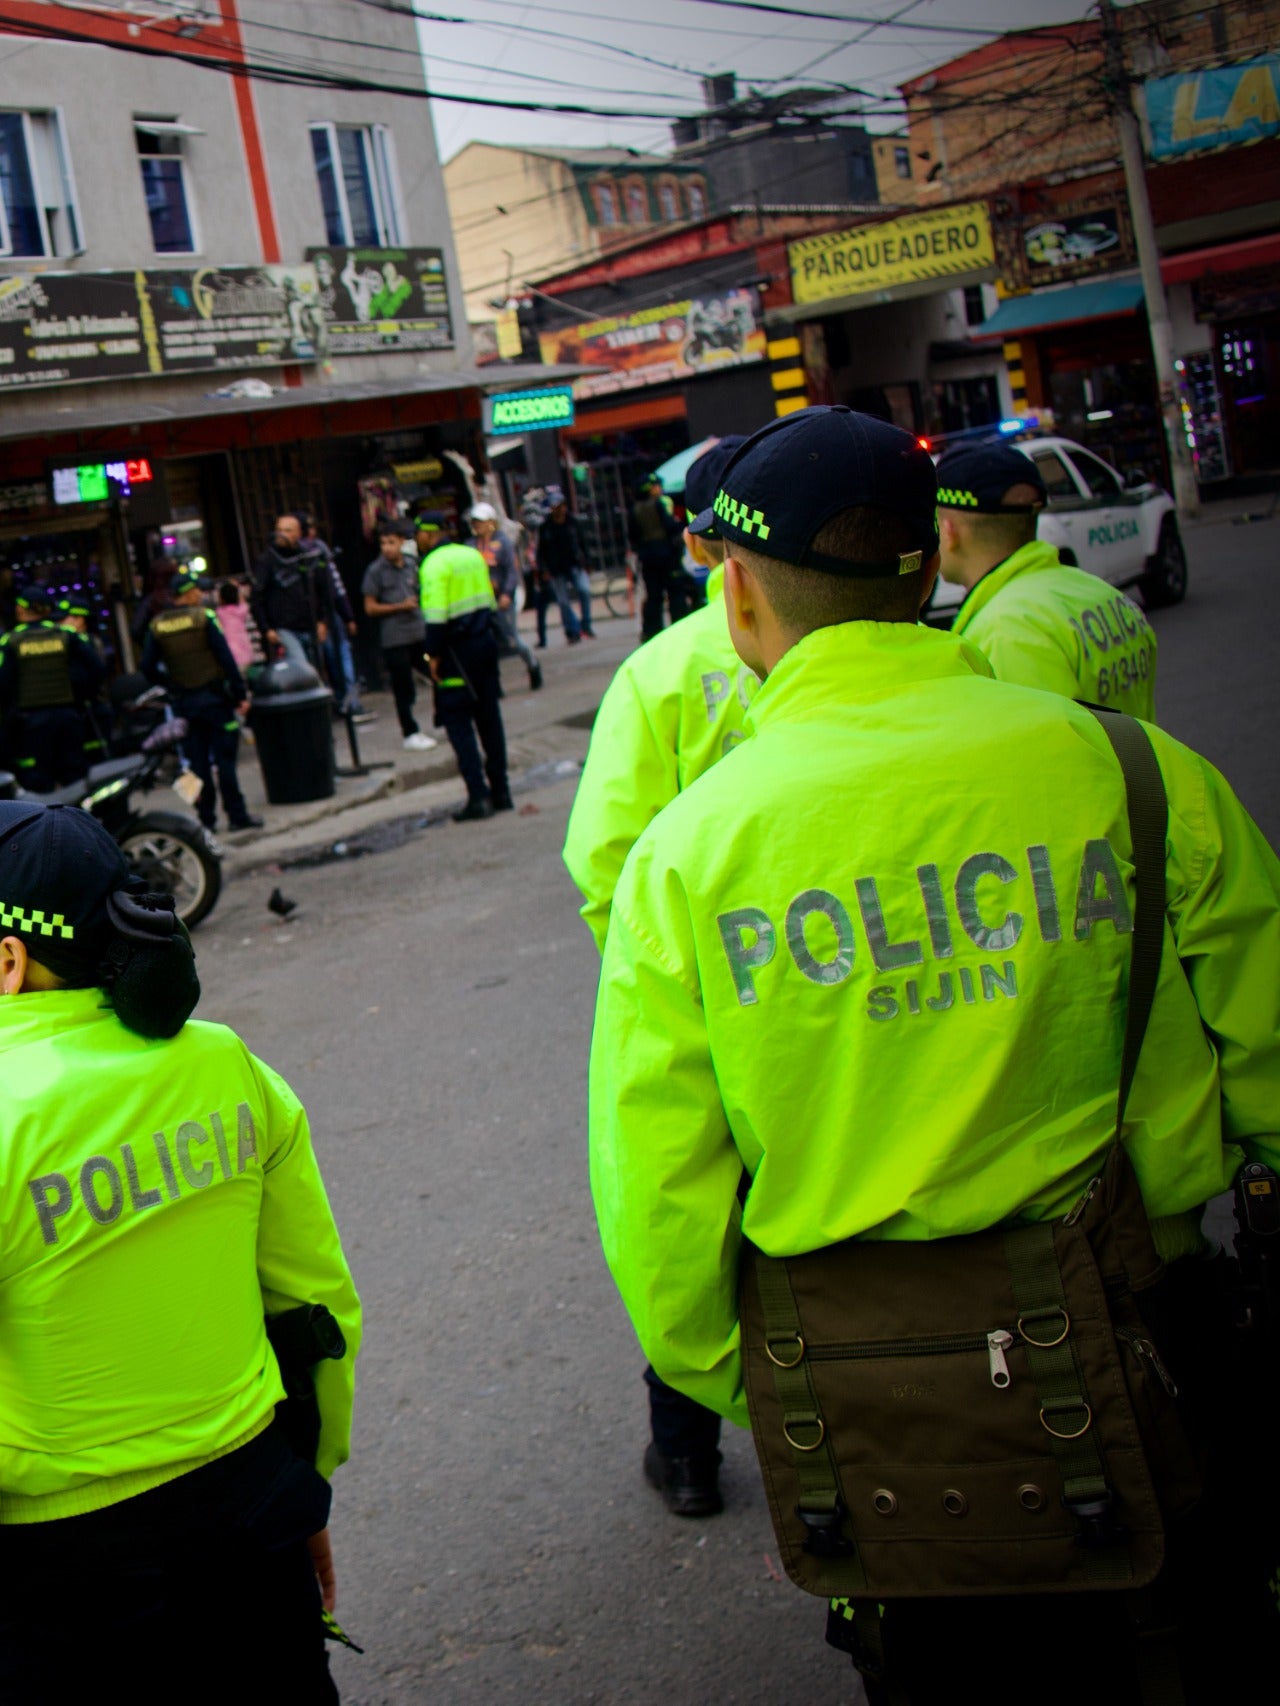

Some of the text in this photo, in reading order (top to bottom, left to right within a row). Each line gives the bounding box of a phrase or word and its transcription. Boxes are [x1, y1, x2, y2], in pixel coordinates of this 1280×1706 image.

[802, 223, 981, 281] PARQUEADERO
[1088, 519, 1140, 547] POLICIA
[717, 837, 1137, 1006] POLICIA
[866, 959, 1019, 1022] SIJIN
[29, 1102, 260, 1246] POLICIA
